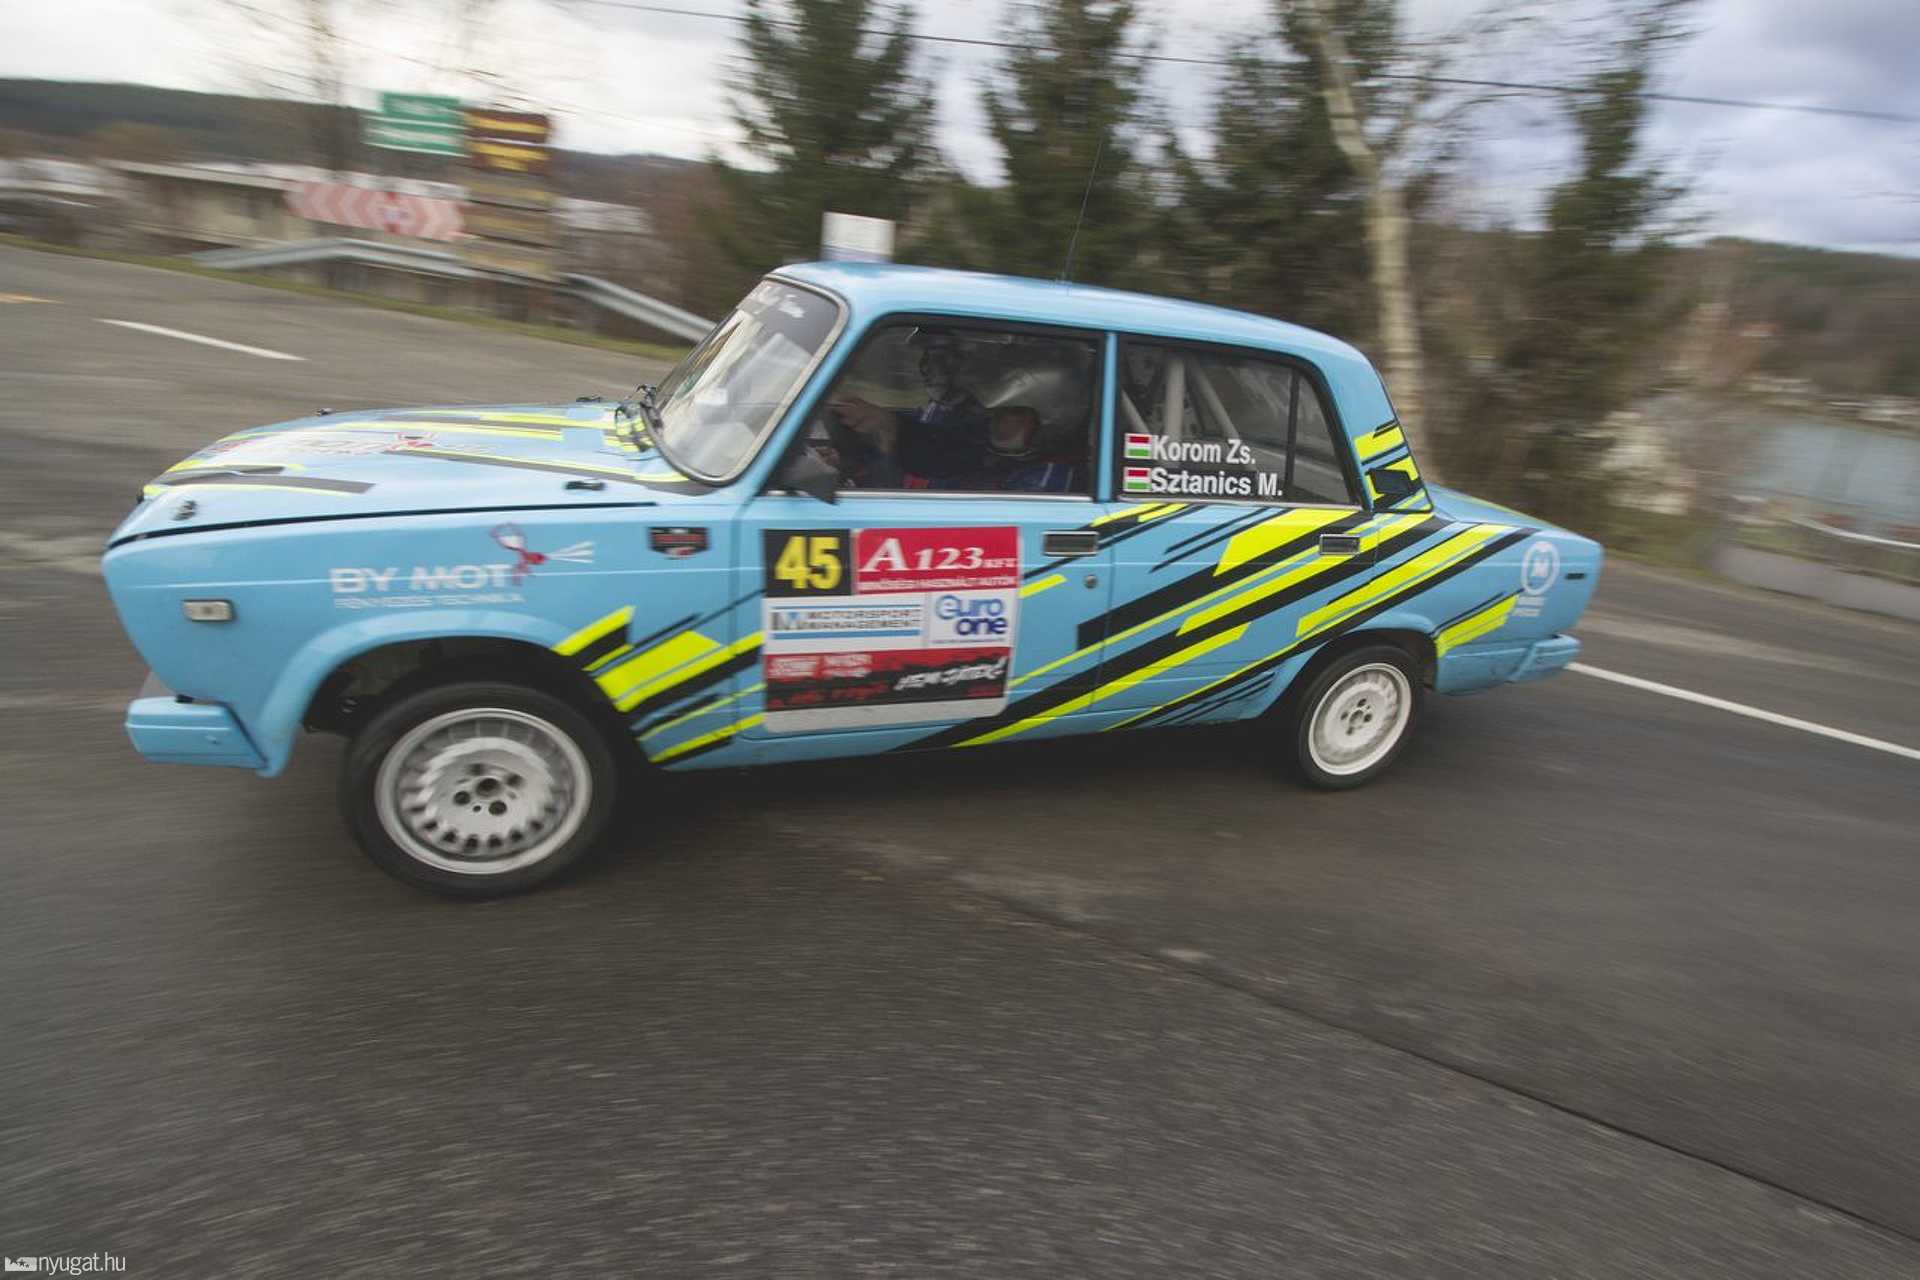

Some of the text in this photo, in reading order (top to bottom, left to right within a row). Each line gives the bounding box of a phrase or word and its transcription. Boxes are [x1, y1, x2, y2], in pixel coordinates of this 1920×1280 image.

[1152, 435, 1256, 465] Korom Zs.
[1151, 467, 1283, 496] Sztanics M.
[774, 535, 842, 589] 45
[329, 567, 398, 593] BY
[934, 594, 1004, 620] euro
[955, 616, 1008, 636] one
